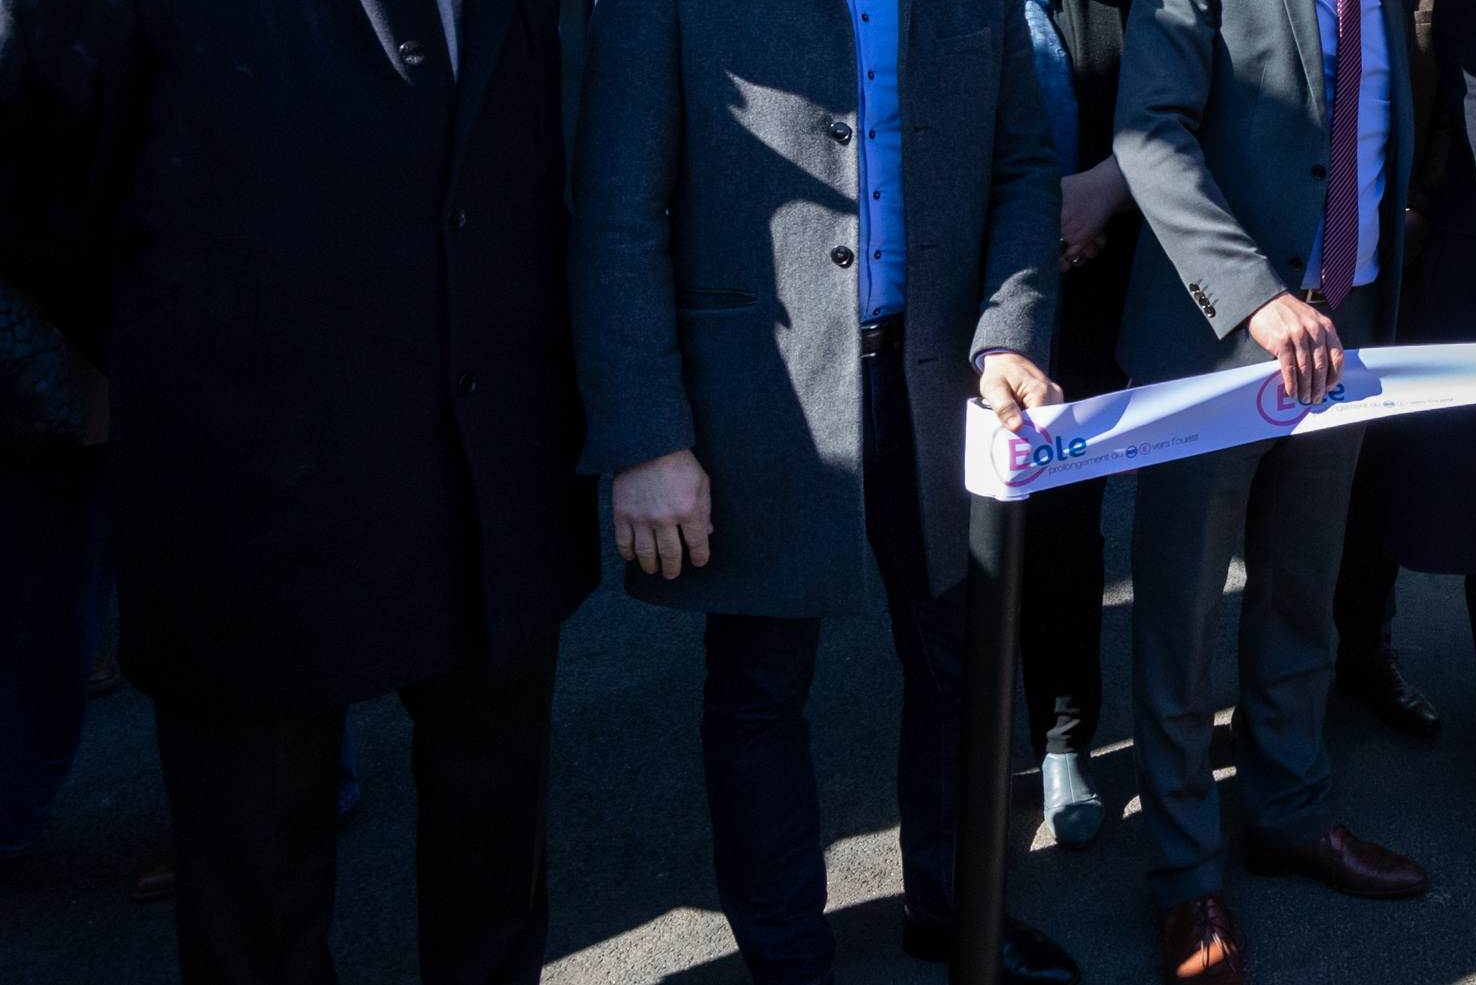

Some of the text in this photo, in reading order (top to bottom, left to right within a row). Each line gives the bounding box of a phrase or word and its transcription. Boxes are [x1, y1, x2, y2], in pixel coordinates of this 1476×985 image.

[1276, 382, 1345, 412] Ee
[1008, 436, 1087, 471] Eole
[1048, 454, 1110, 476] prolongement
[1111, 450, 1124, 460] du
[1152, 440, 1170, 450] vers
